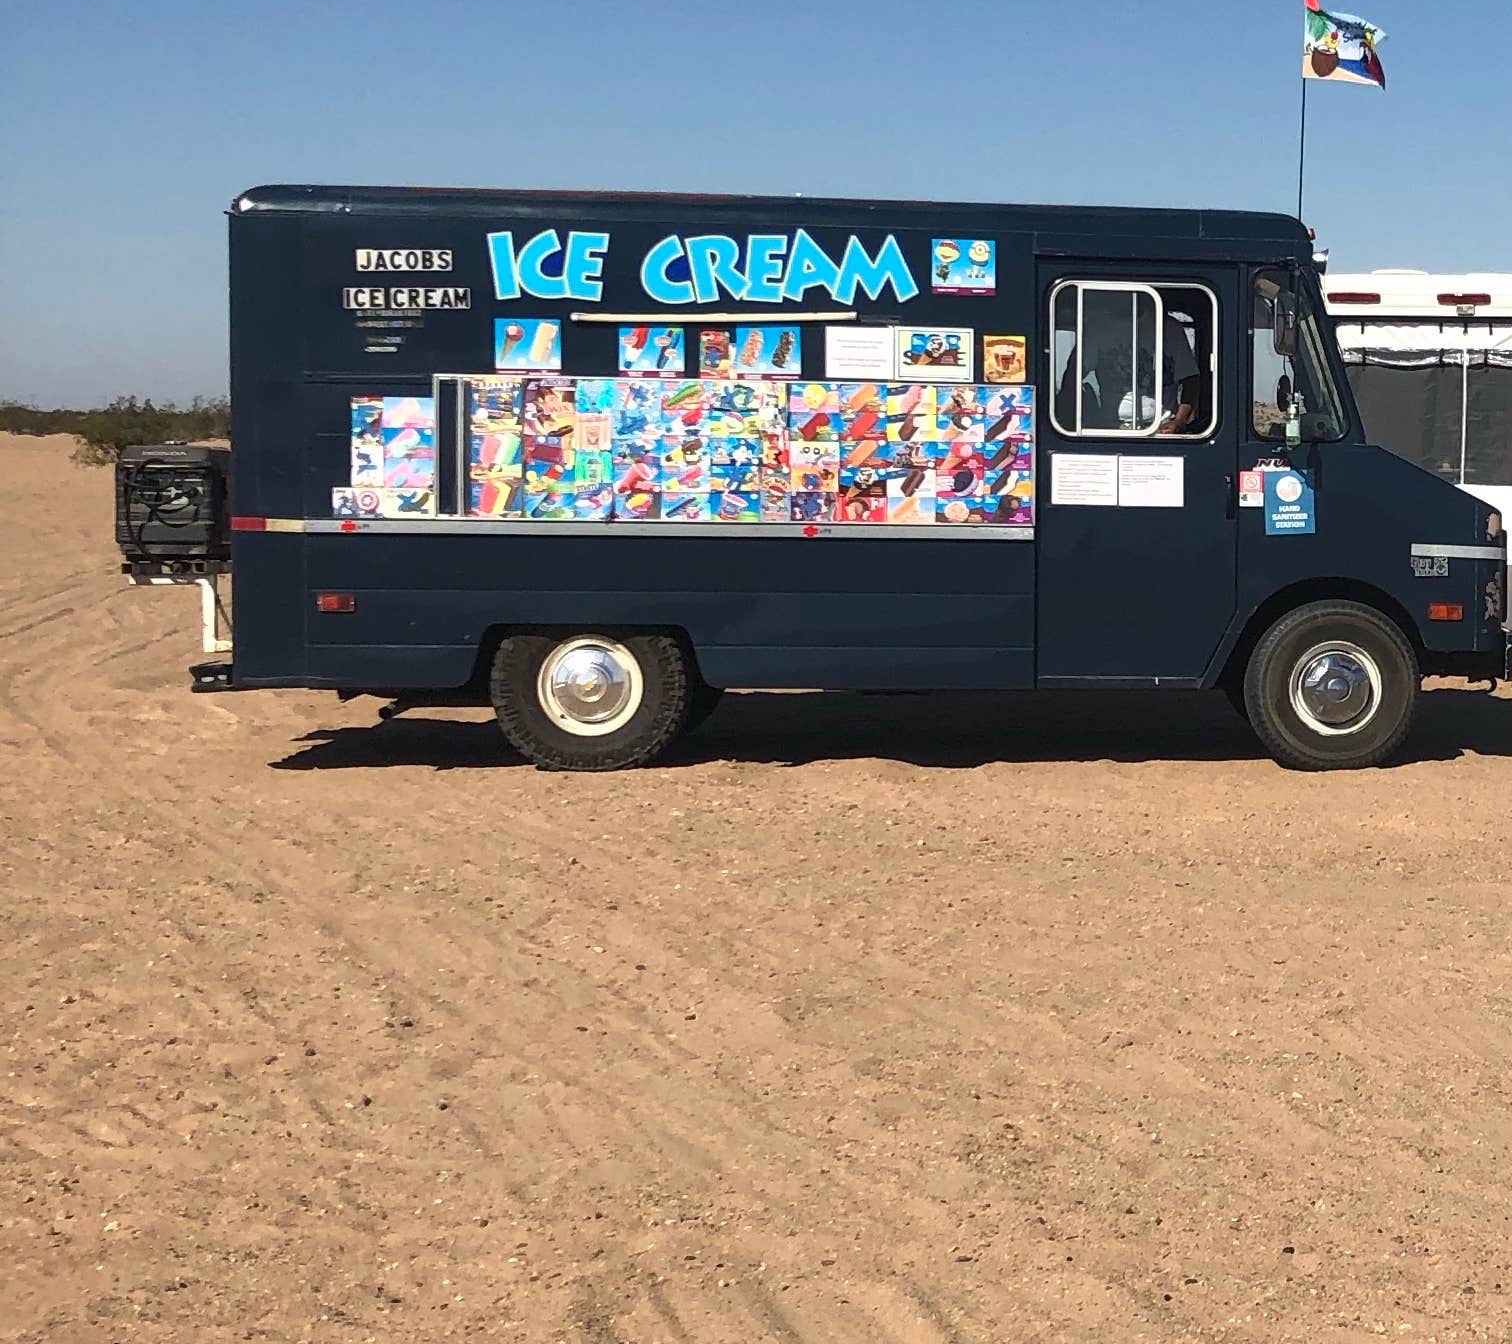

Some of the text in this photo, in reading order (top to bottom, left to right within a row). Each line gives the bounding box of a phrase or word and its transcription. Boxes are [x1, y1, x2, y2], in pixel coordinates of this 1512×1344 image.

[360, 250, 451, 270] JACOBS
[487, 229, 919, 305] ICE CREAM
[345, 288, 469, 308] ICE CREAM
[1272, 513, 1308, 521] SANITIZER
